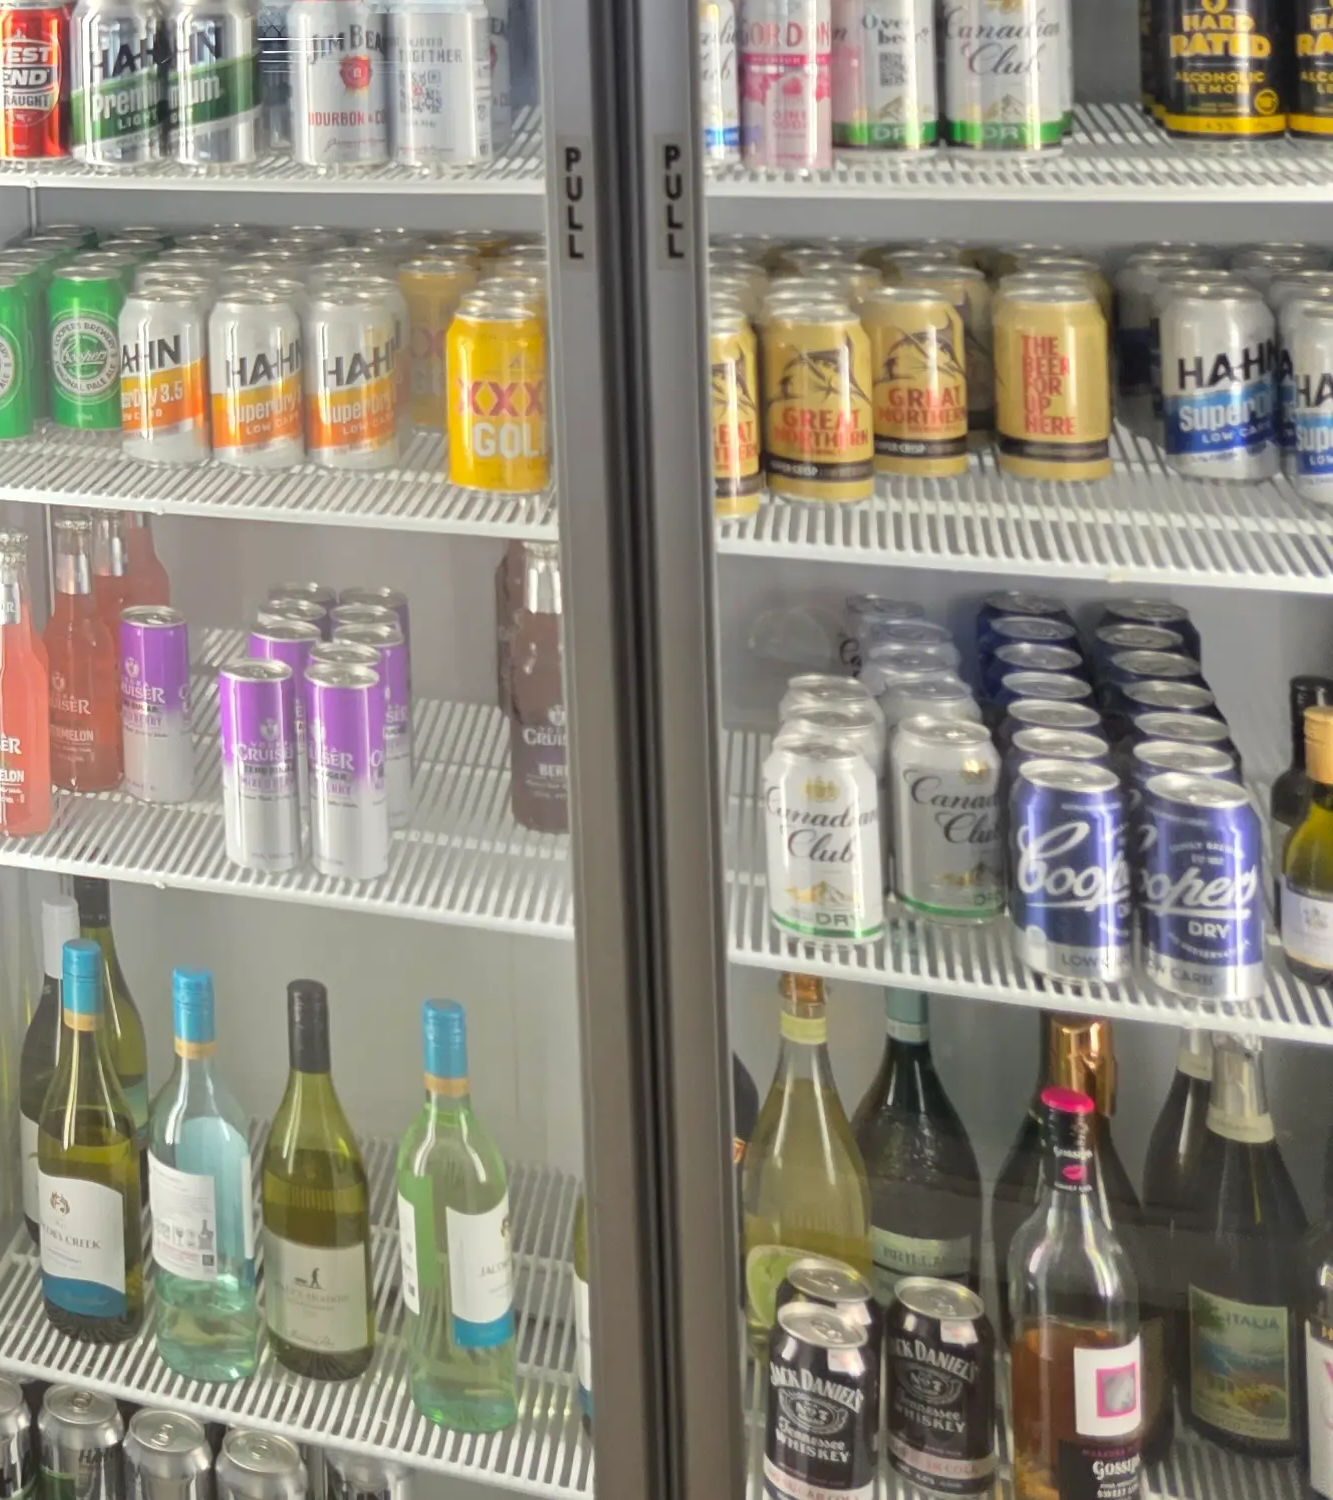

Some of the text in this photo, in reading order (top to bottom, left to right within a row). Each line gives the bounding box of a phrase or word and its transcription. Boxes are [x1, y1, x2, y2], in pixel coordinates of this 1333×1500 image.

[1182, 13, 1256, 32] HARD
[308, 31, 345, 65] JIM
[1169, 32, 1272, 58] RATED
[1175, 71, 1266, 83] ALCOHOLIC
[1189, 83, 1250, 95] LEMON
[564, 146, 585, 259] PULL
[663, 145, 685, 260] PULL
[83, 320, 116, 351] BREWERY
[1021, 334, 1059, 356] THE
[1023, 354, 1070, 376] BEER
[86, 377, 106, 392] PALE
[159, 380, 183, 404] 3.5
[887, 384, 962, 406] GREAT
[1024, 374, 1062, 396] FOR
[1024, 394, 1052, 415] UP
[782, 406, 861, 431] GREAT
[1024, 414, 1077, 436] HERE
[472, 421, 547, 460] GOL
[773, 425, 869, 449] NORTHERN
[1201, 432, 1233, 444] LOW
[786, 829, 858, 866] Club
[1188, 920, 1231, 940] DRY
[65, 1235, 101, 1250] CREEK
[914, 1338, 979, 1383] DANIEL'S
[770, 1360, 865, 1414] JACK DANIEL'S
[775, 1427, 850, 1464] WHISKEY
